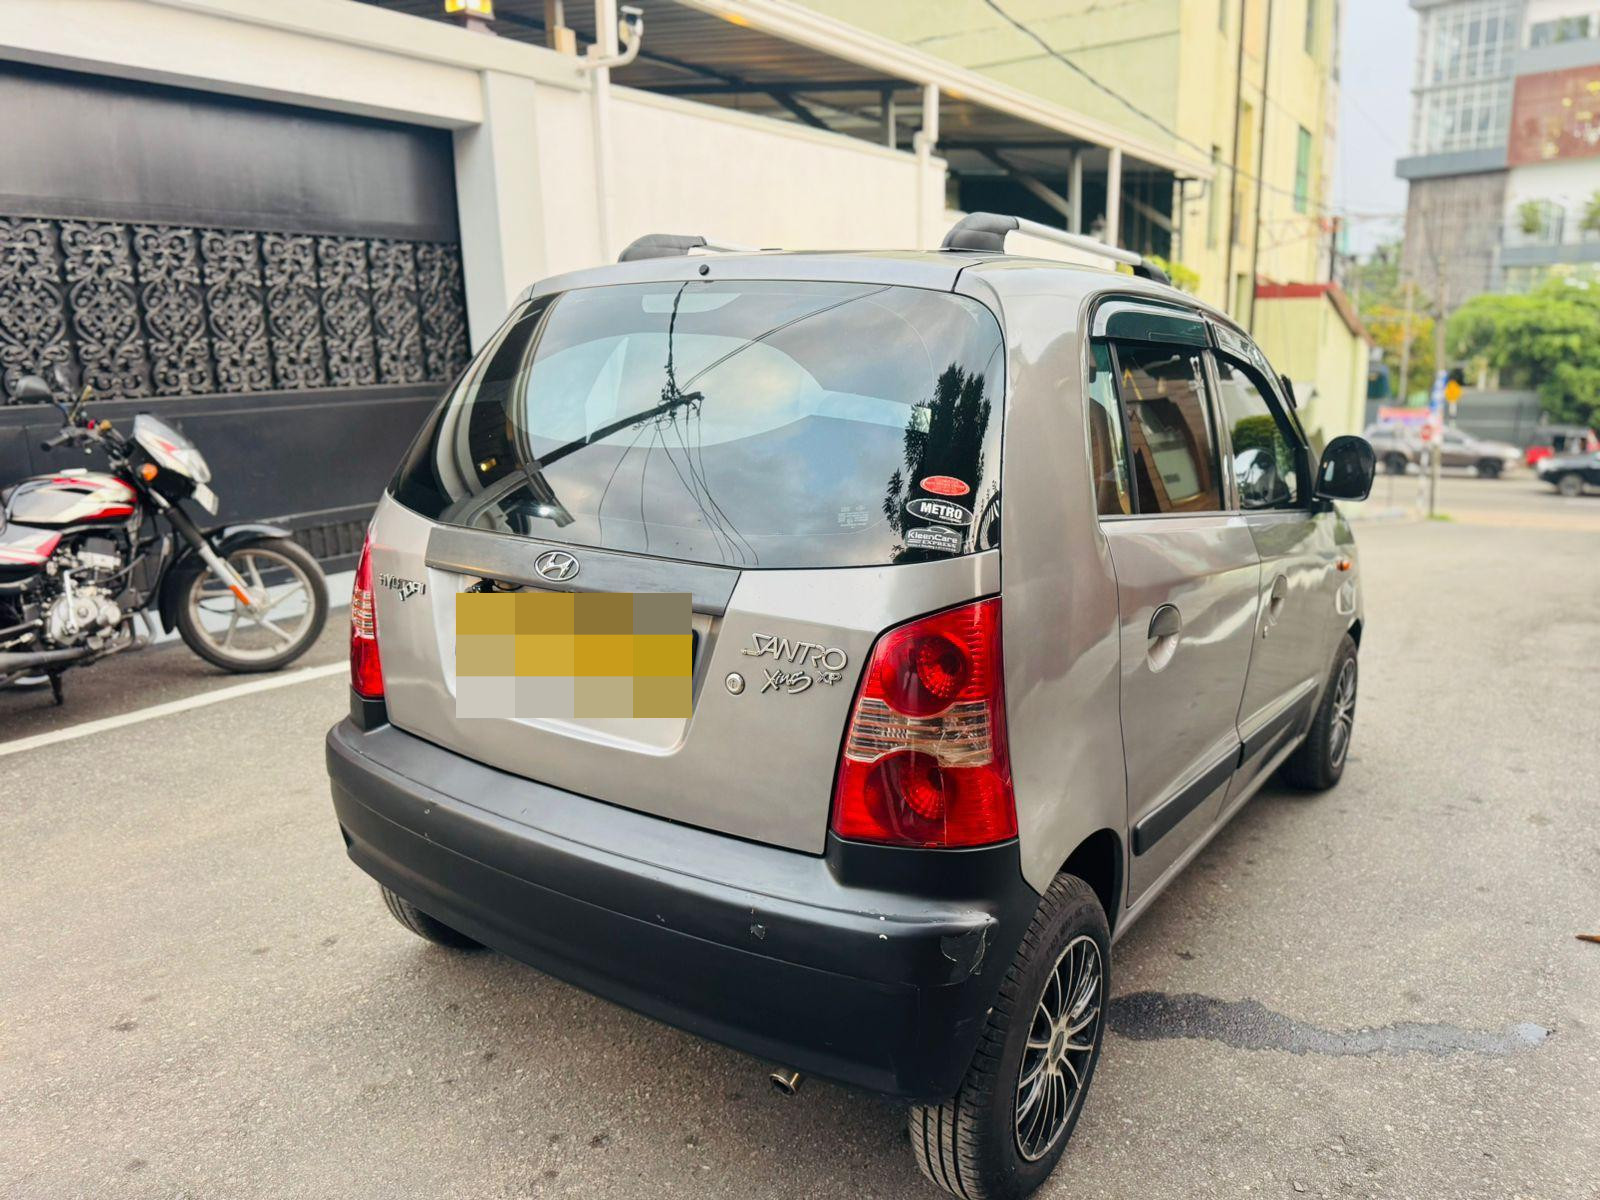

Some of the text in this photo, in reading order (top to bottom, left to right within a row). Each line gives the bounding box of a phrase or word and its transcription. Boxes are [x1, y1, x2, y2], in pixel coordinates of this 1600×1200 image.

[920, 501, 963, 520] METRO
[908, 531, 958, 544] KleenCare
[741, 632, 848, 671] SANTRO
